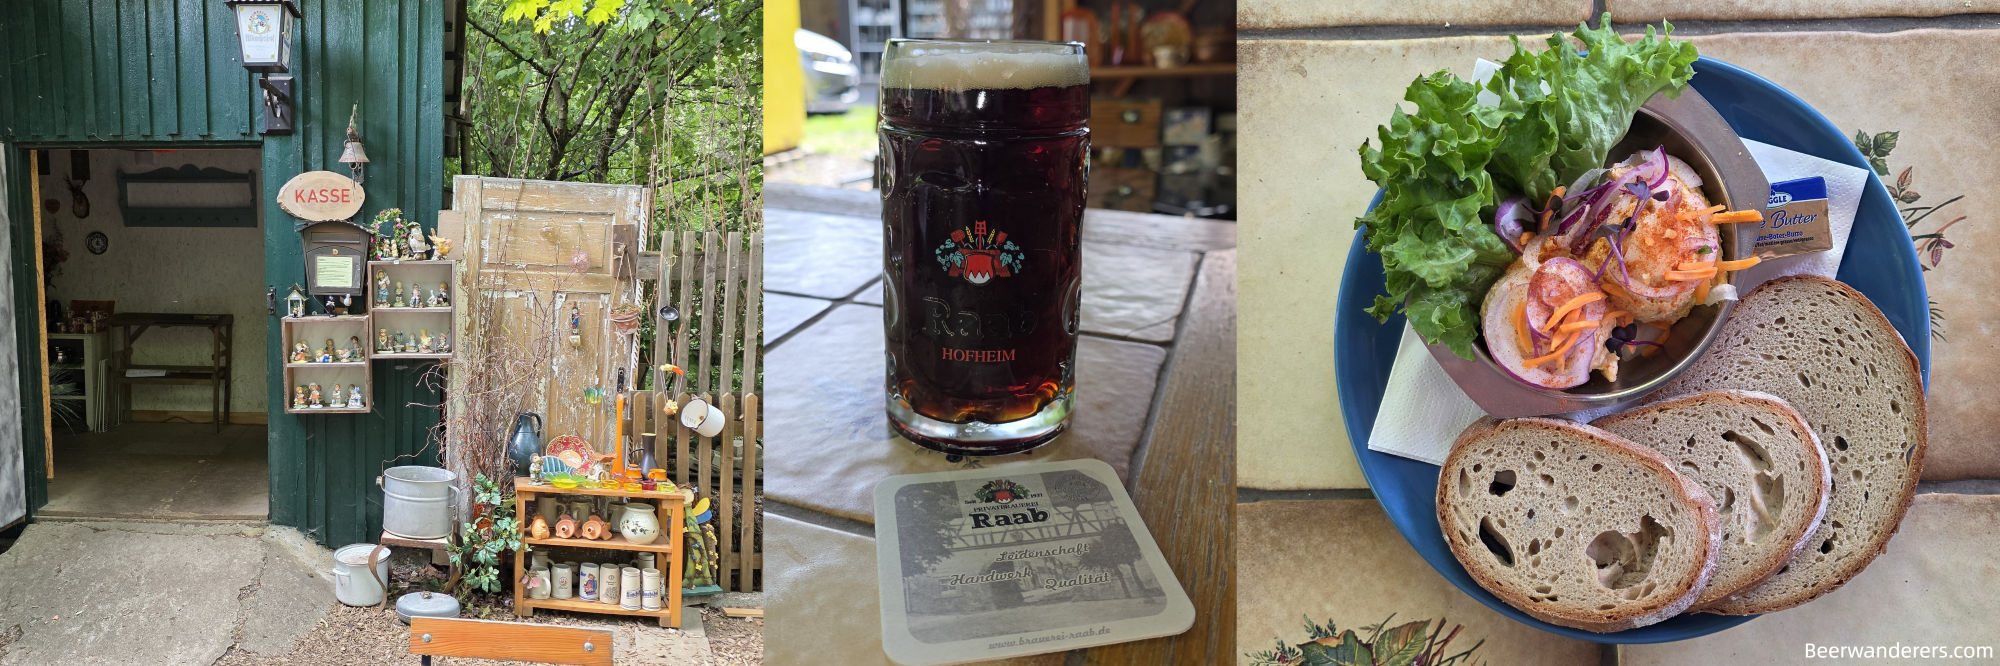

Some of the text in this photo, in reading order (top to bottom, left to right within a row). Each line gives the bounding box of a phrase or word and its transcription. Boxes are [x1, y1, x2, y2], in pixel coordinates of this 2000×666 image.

[295, 189, 350, 203] KASSE
[1768, 195, 1787, 204] GGLE
[1770, 210, 1817, 229] Butter
[922, 296, 1039, 338] Raab
[942, 348, 1016, 363] HOFHEIM
[973, 502, 1039, 512] PRIVATBRAUEREI
[969, 507, 1050, 529] Raab
[996, 543, 1089, 562] Leidenschaft
[950, 568, 1032, 585] Handwerk
[1045, 572, 1110, 590] Qualität
[988, 626, 1110, 649] www.brauerei-raab.de
